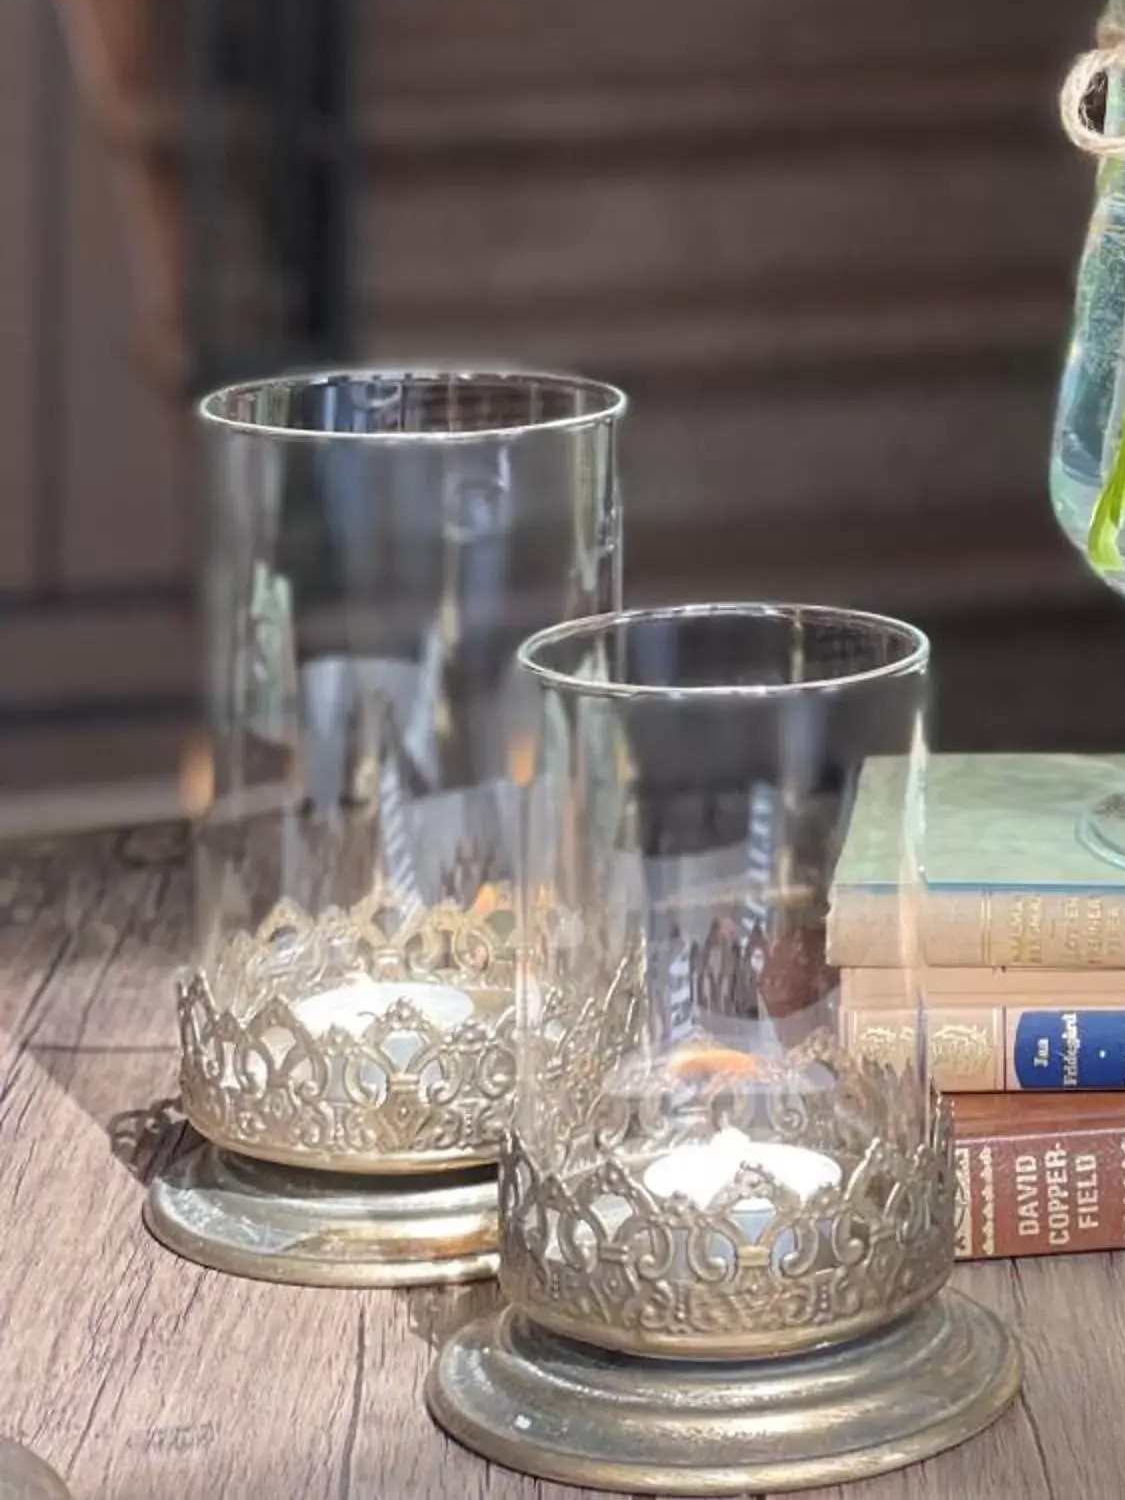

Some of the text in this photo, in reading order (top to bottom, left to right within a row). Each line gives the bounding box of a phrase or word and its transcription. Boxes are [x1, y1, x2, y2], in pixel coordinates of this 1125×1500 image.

[1033, 1037, 1050, 1068] Jan
[1015, 1155, 1040, 1237] DAVID
[1044, 1142, 1070, 1246] COPPER-
[1075, 1154, 1099, 1229] FIELD
